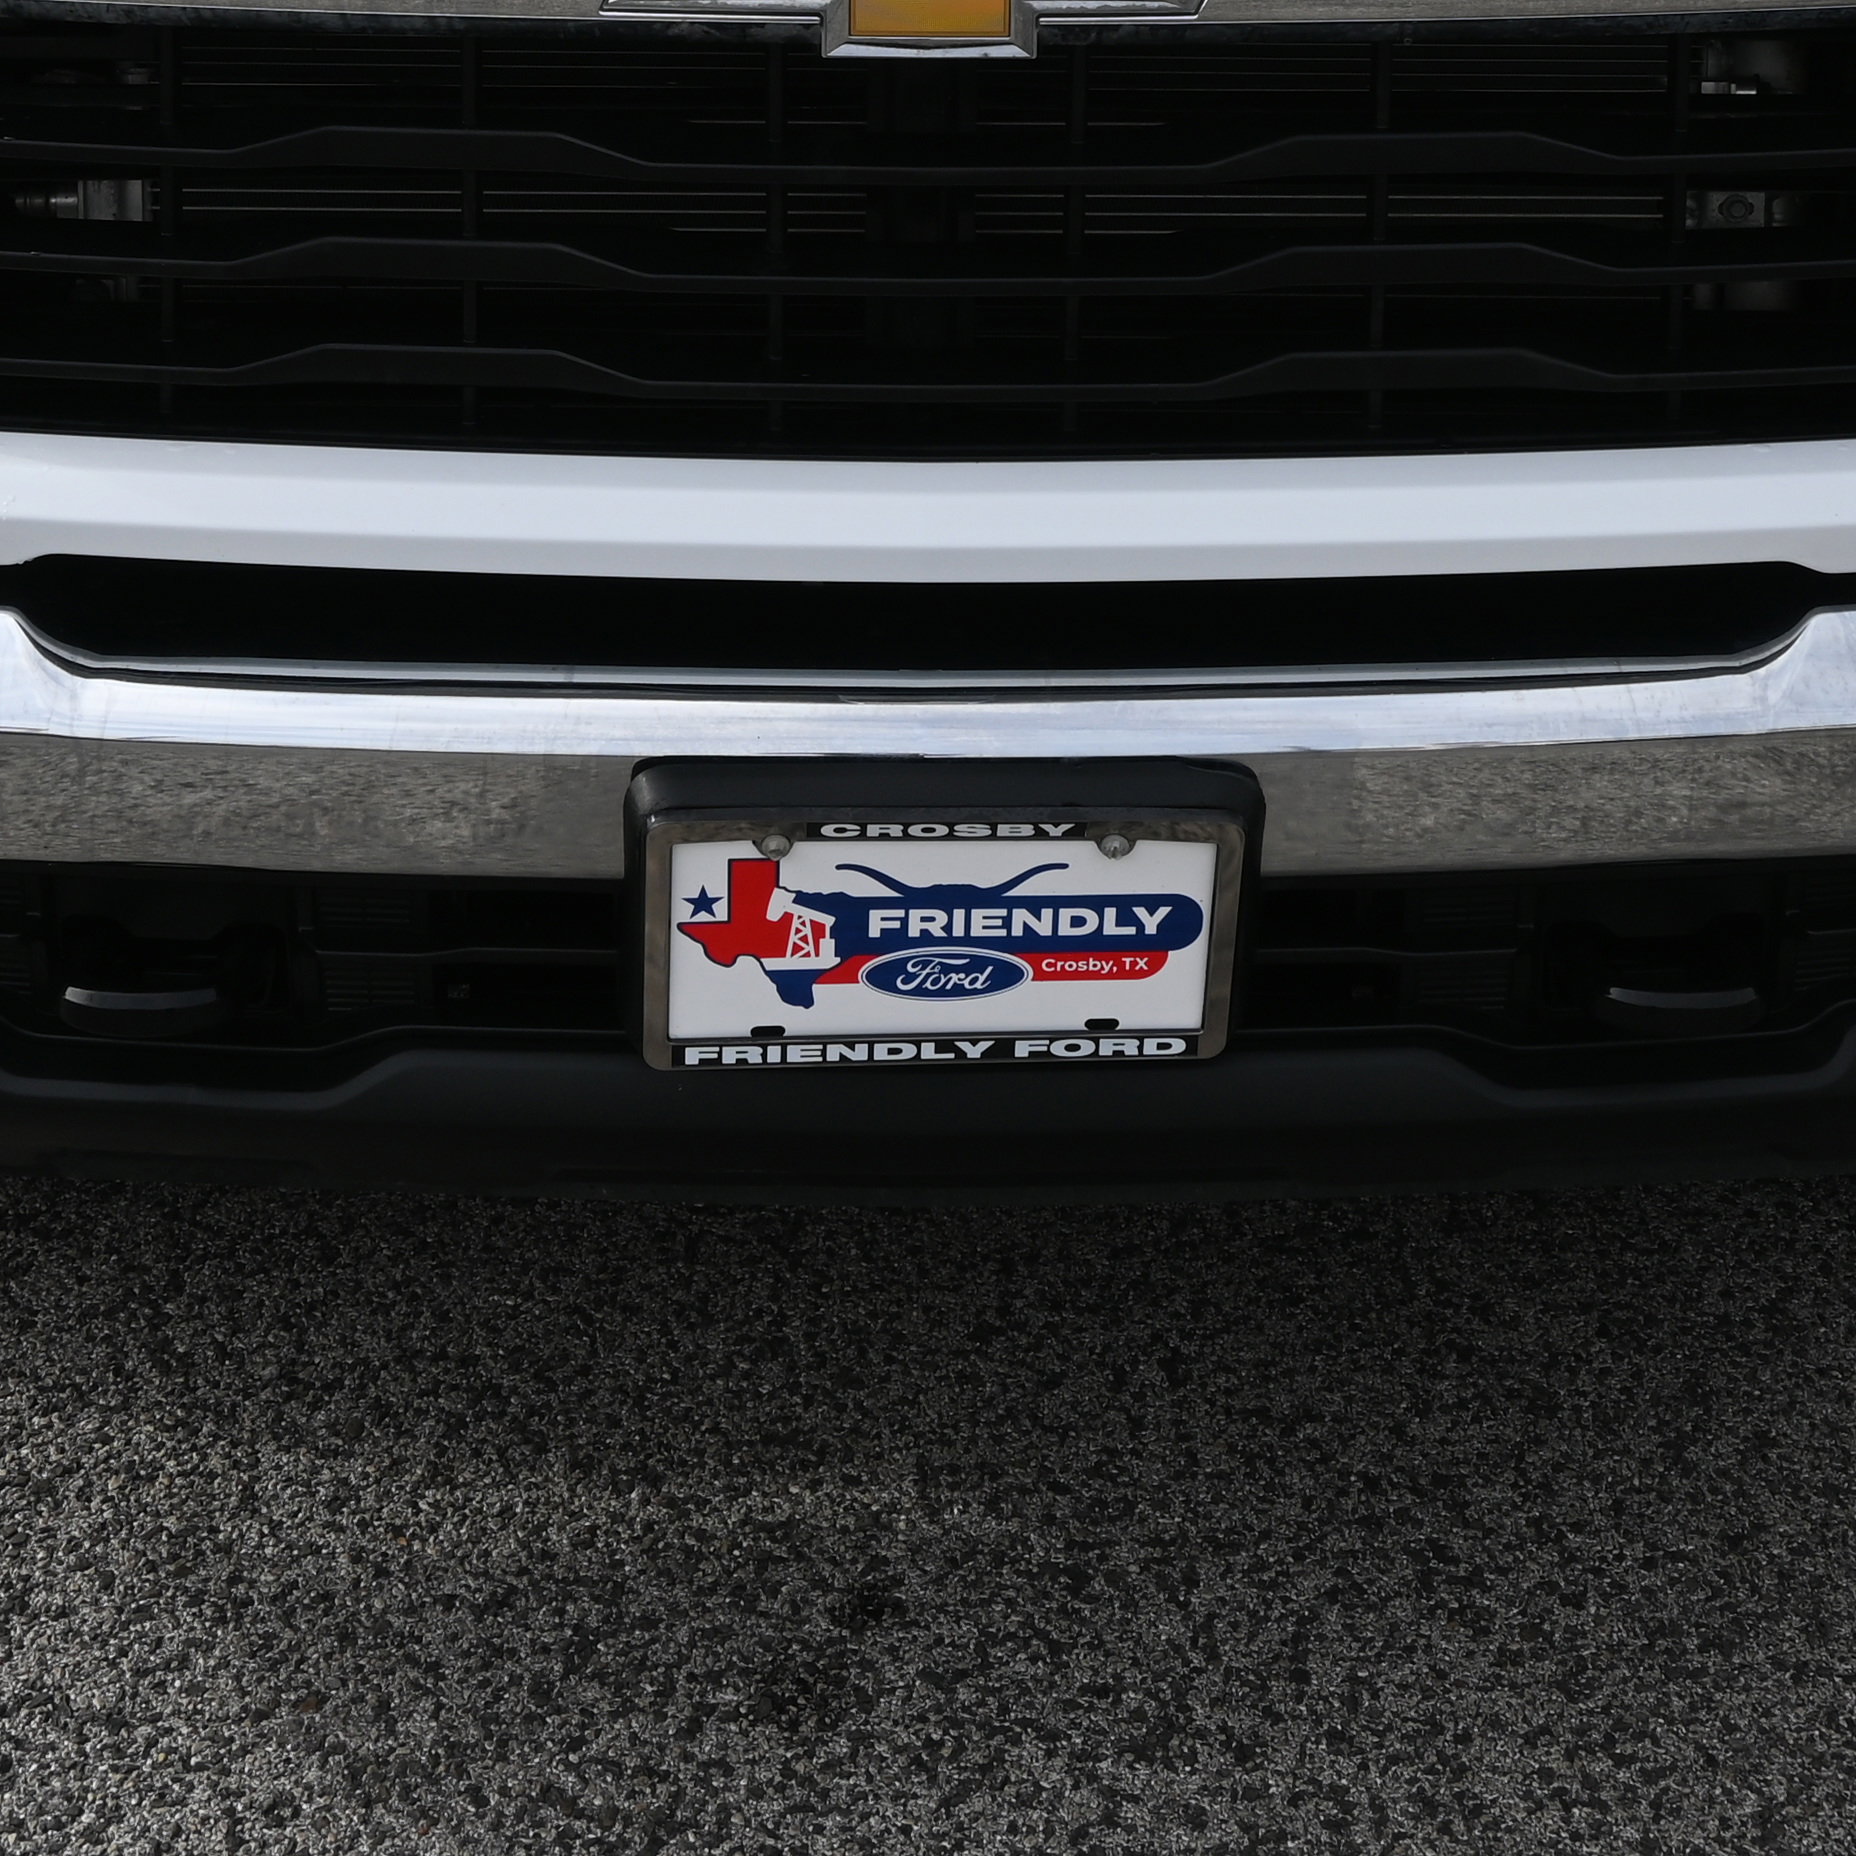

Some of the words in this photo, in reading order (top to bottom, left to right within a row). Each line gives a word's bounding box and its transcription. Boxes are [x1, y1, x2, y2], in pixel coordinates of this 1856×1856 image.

[818, 822, 1078, 839] CROSBY
[867, 905, 1173, 939] FRIENDLY
[895, 956, 992, 993] Ford
[1040, 955, 1117, 977] Crosby,
[1121, 957, 1149, 971] TX
[683, 1040, 996, 1065] FRIENDLY
[1012, 1036, 1188, 1058] FORD
